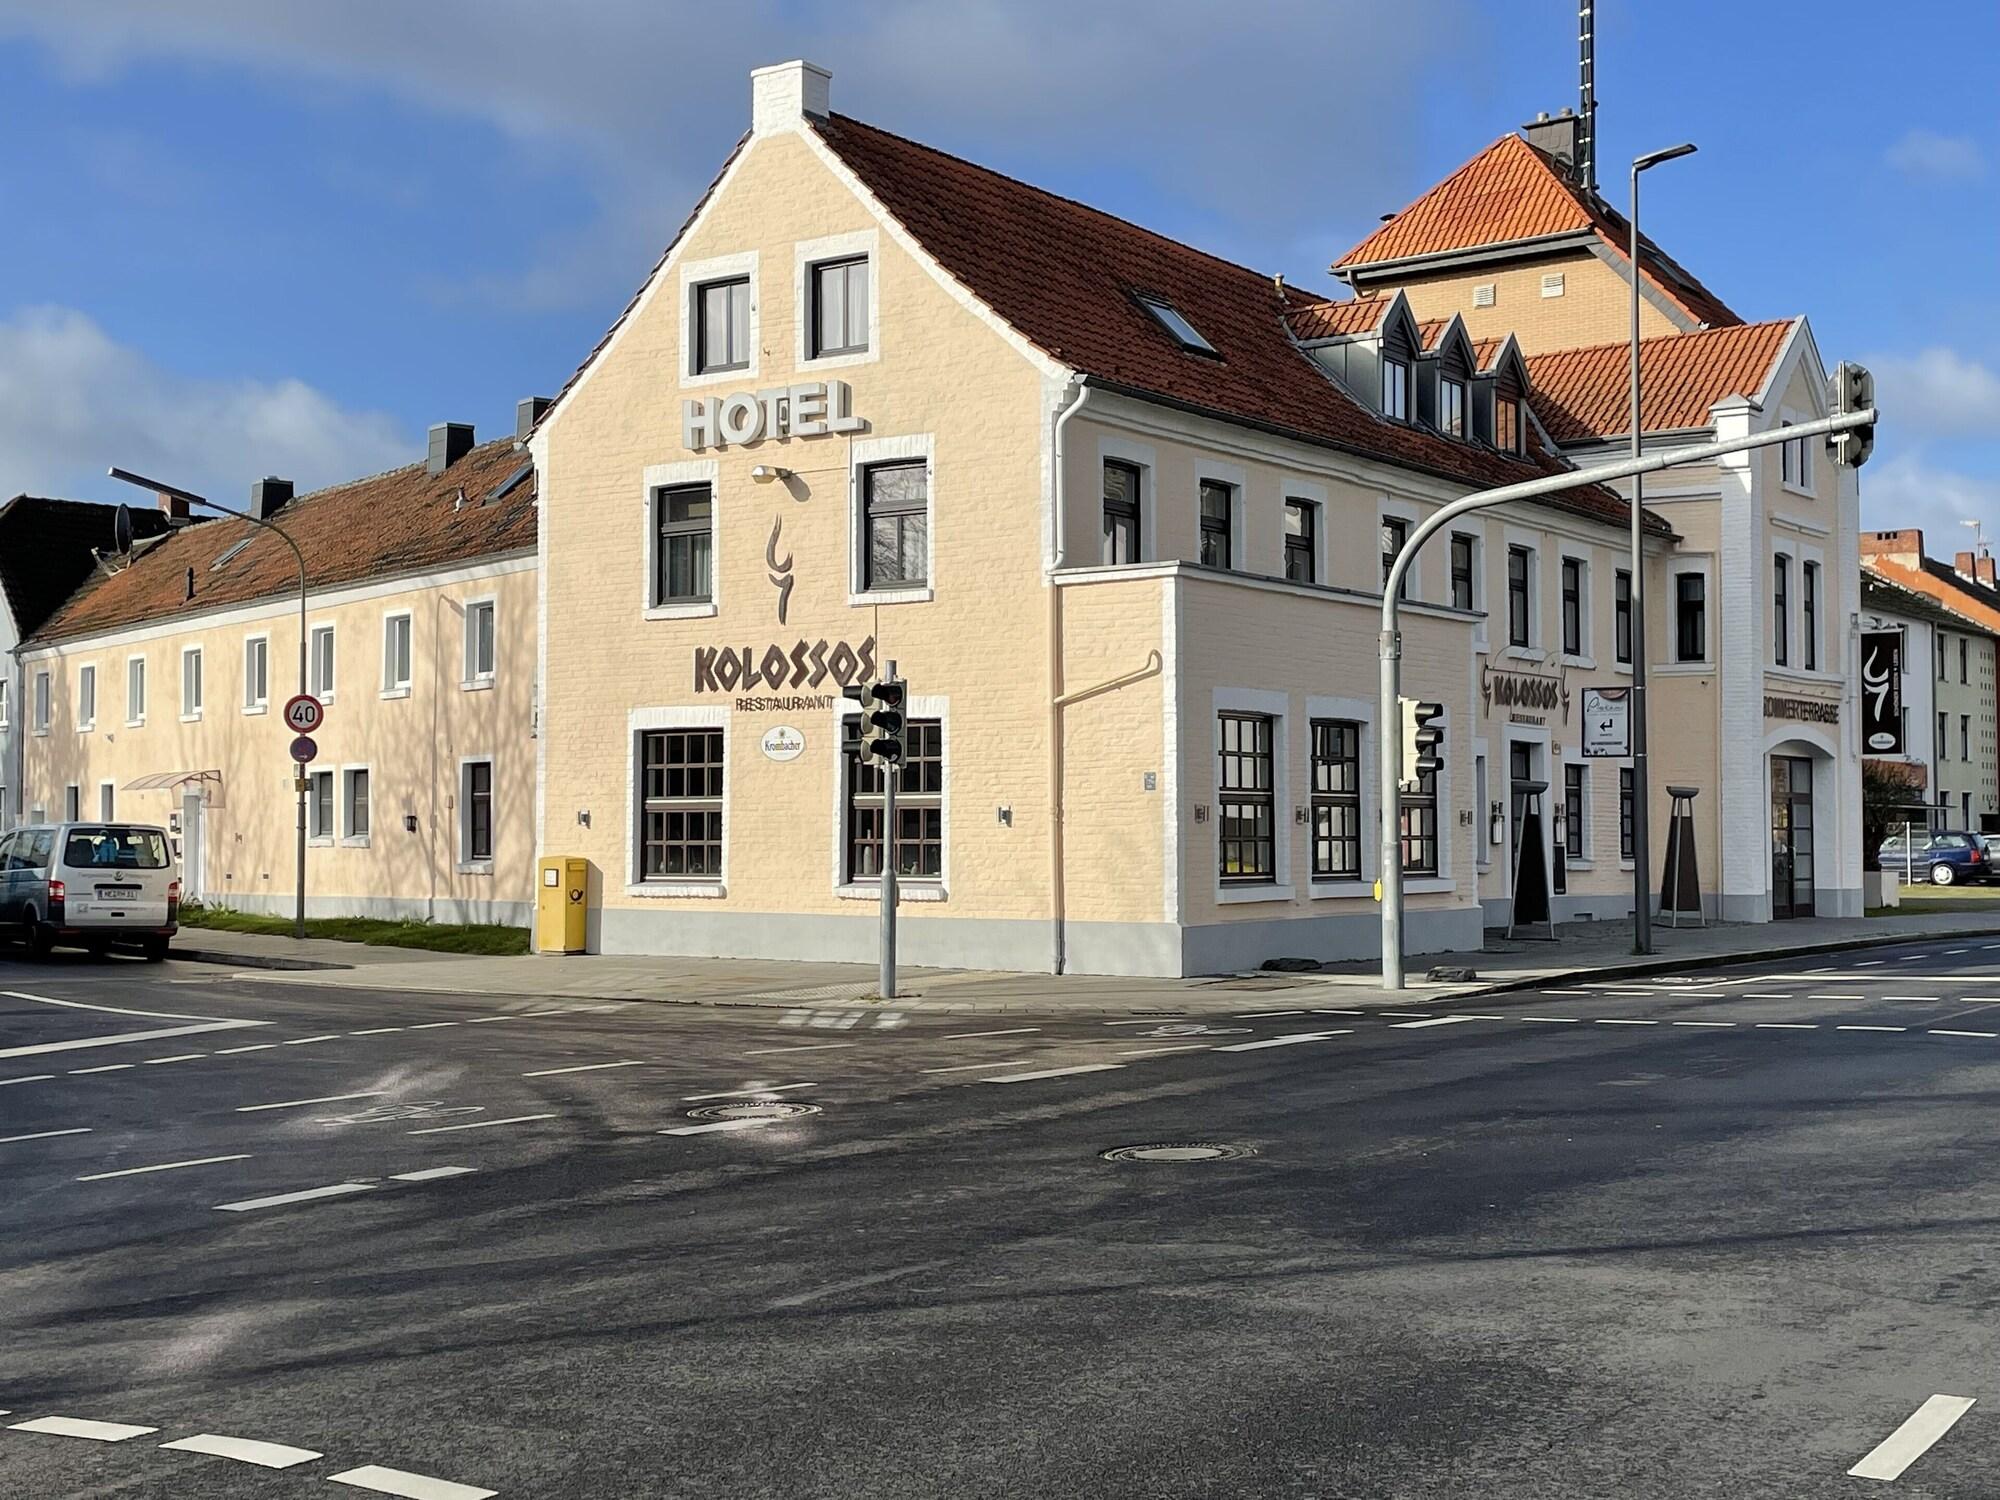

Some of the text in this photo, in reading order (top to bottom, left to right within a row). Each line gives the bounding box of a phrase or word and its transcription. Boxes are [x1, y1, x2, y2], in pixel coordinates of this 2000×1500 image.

[682, 380, 866, 450] HOTEL
[695, 635, 875, 693] KOLOSSOS
[736, 695, 835, 712] RESTAURANT
[1494, 675, 1558, 710] KOLOSSOS
[293, 706, 315, 722] 40
[765, 740, 801, 751] Krombacher
